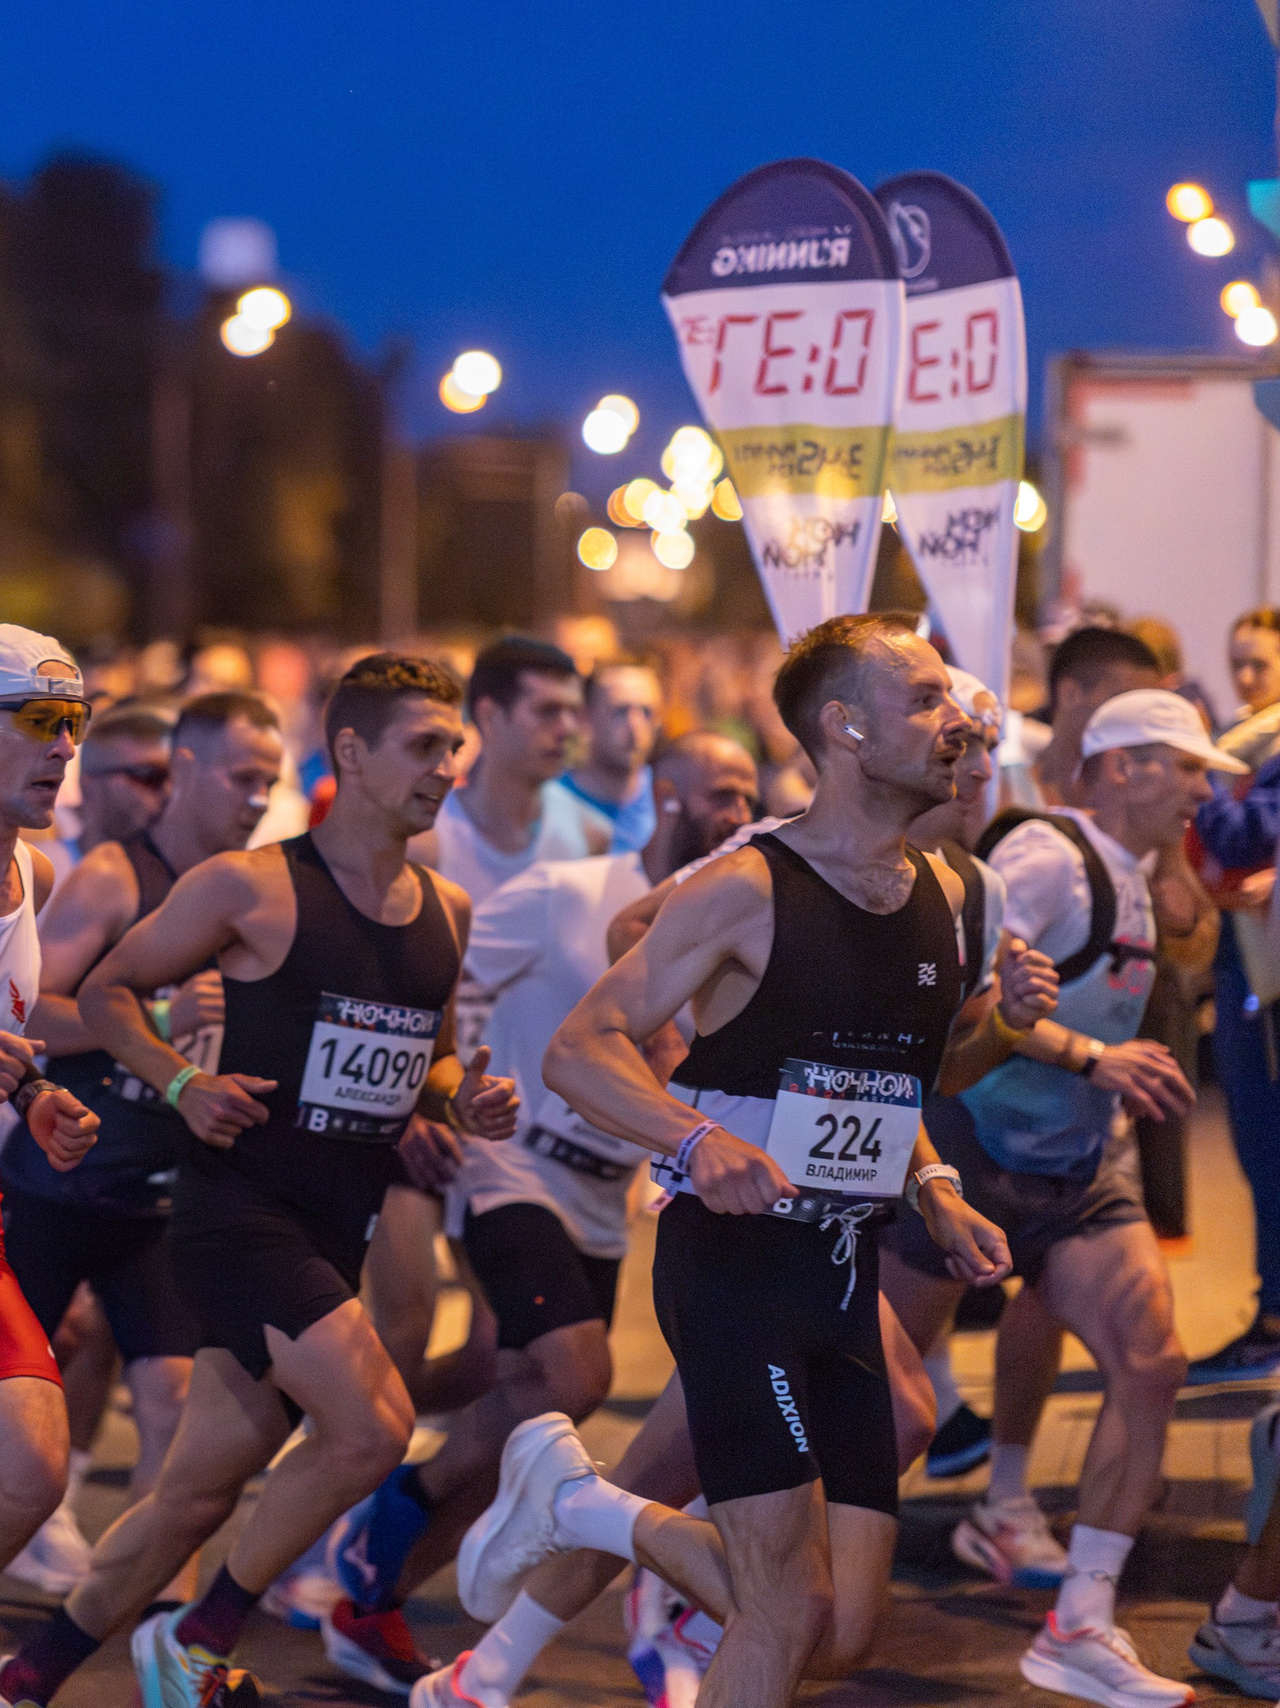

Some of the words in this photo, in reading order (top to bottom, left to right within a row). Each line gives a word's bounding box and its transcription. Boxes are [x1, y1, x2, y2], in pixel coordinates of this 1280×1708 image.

[320, 1037, 427, 1090] 14090
[809, 1113, 883, 1164] 224
[805, 1163, 878, 1183] ВЛАДИМИР
[767, 1363, 810, 1453] ADIXION
